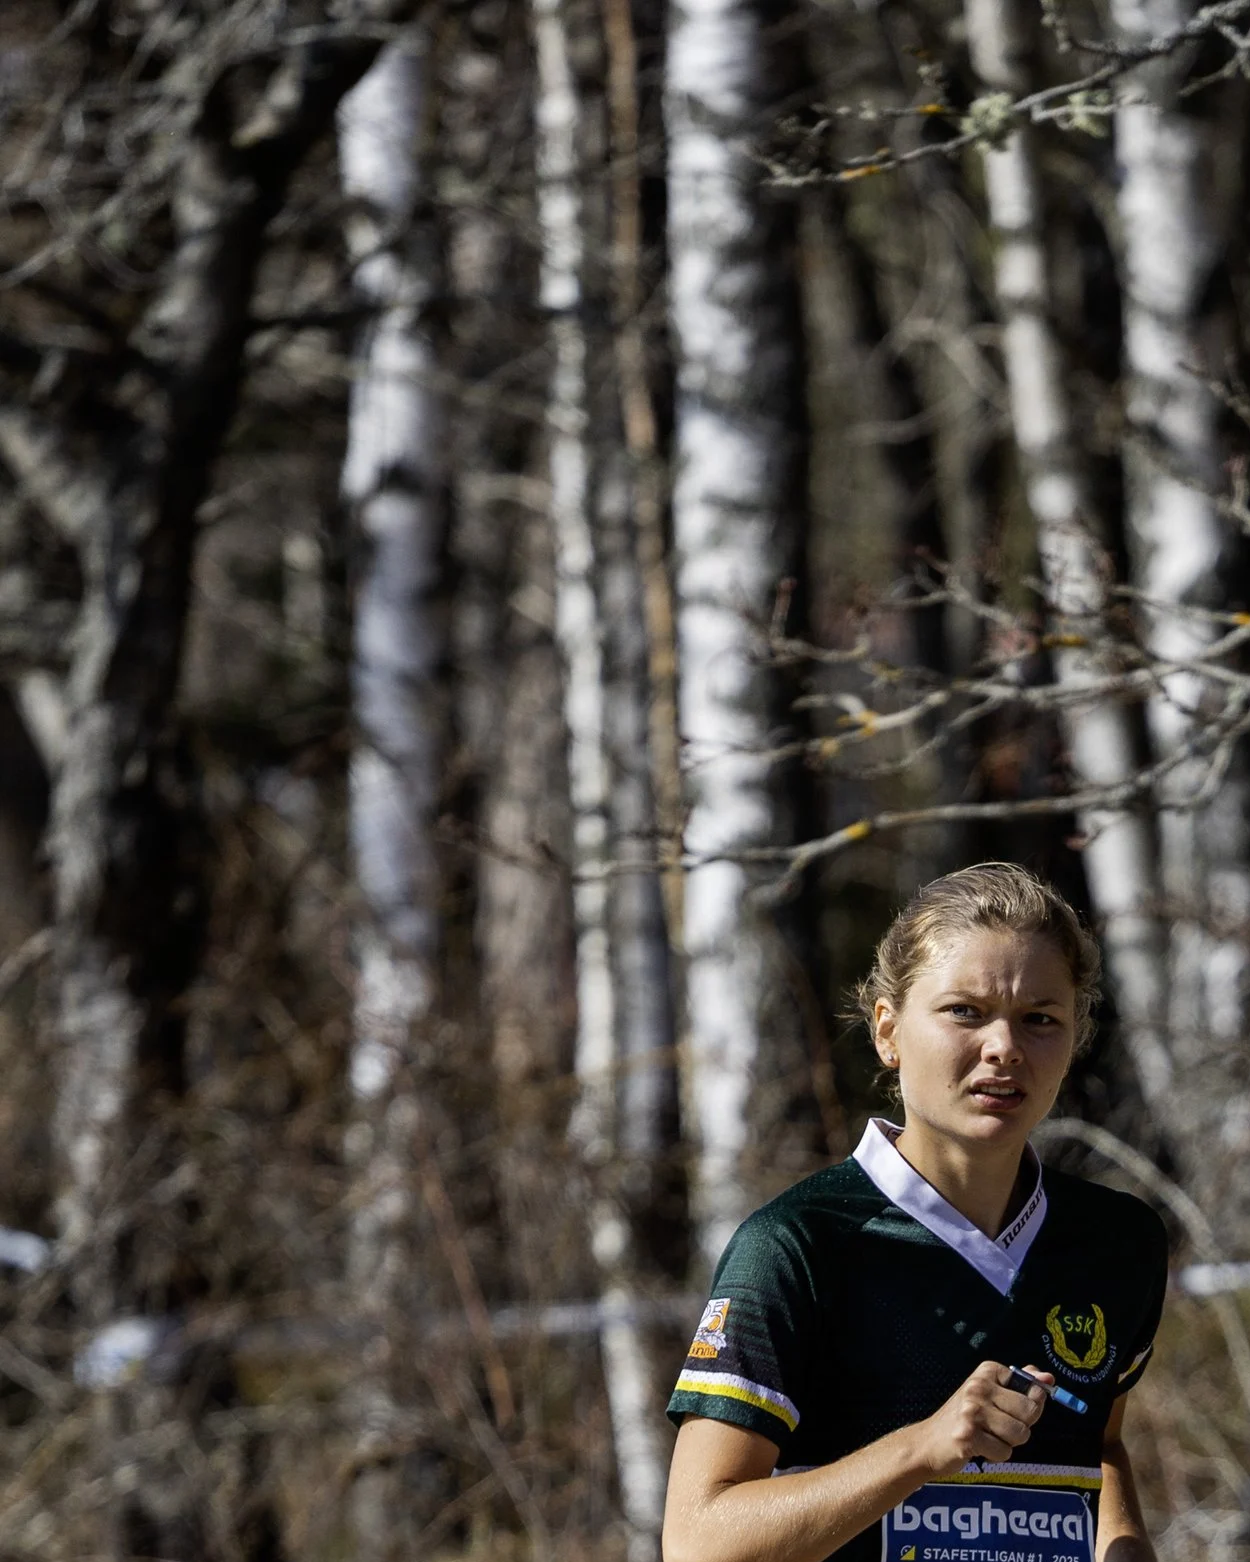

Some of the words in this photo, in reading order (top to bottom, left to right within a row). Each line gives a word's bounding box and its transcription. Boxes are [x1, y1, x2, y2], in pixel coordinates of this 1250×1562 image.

[1063, 1314, 1095, 1336] SSK
[1041, 1333, 1090, 1384] ORIENTERING
[893, 1500, 1084, 1541] bagheera
